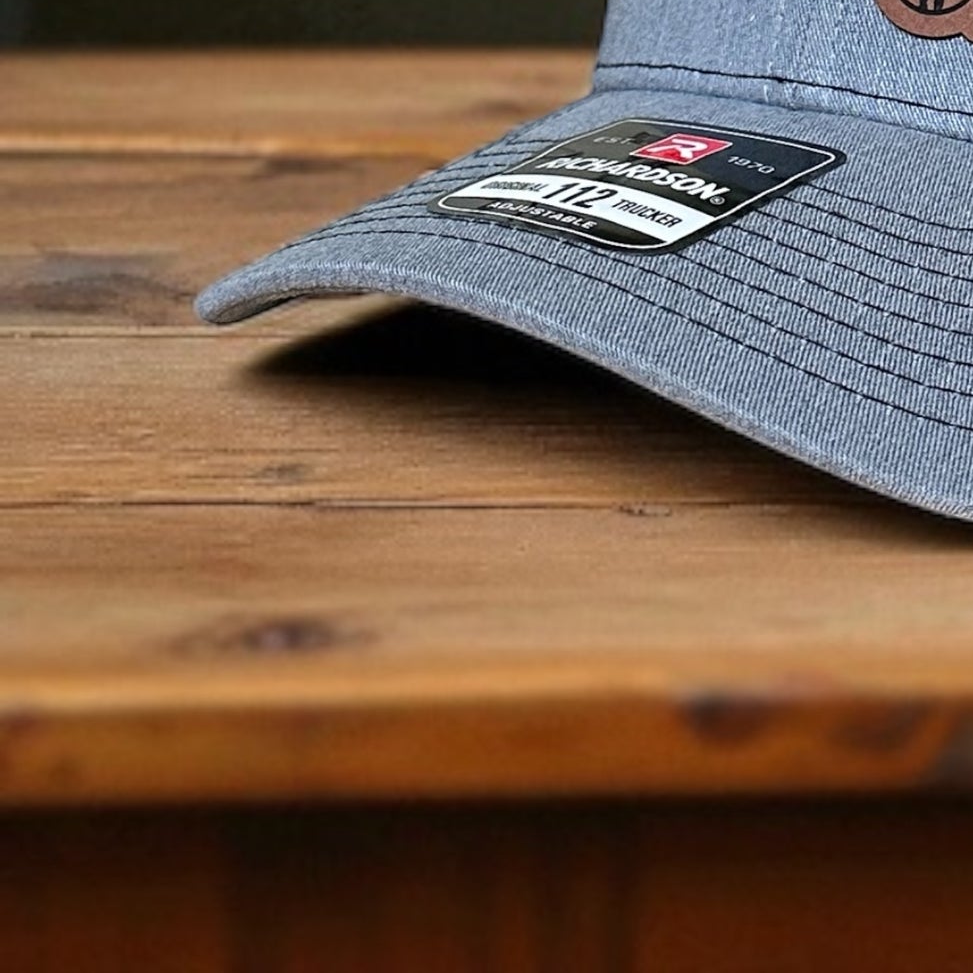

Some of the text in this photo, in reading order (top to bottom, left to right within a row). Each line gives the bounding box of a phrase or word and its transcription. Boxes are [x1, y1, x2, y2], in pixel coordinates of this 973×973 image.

[727, 155, 776, 174] 1970
[487, 201, 598, 229] ADJUSTABLE
[541, 182, 618, 208] 112
[611, 198, 683, 228] TRUCKER
